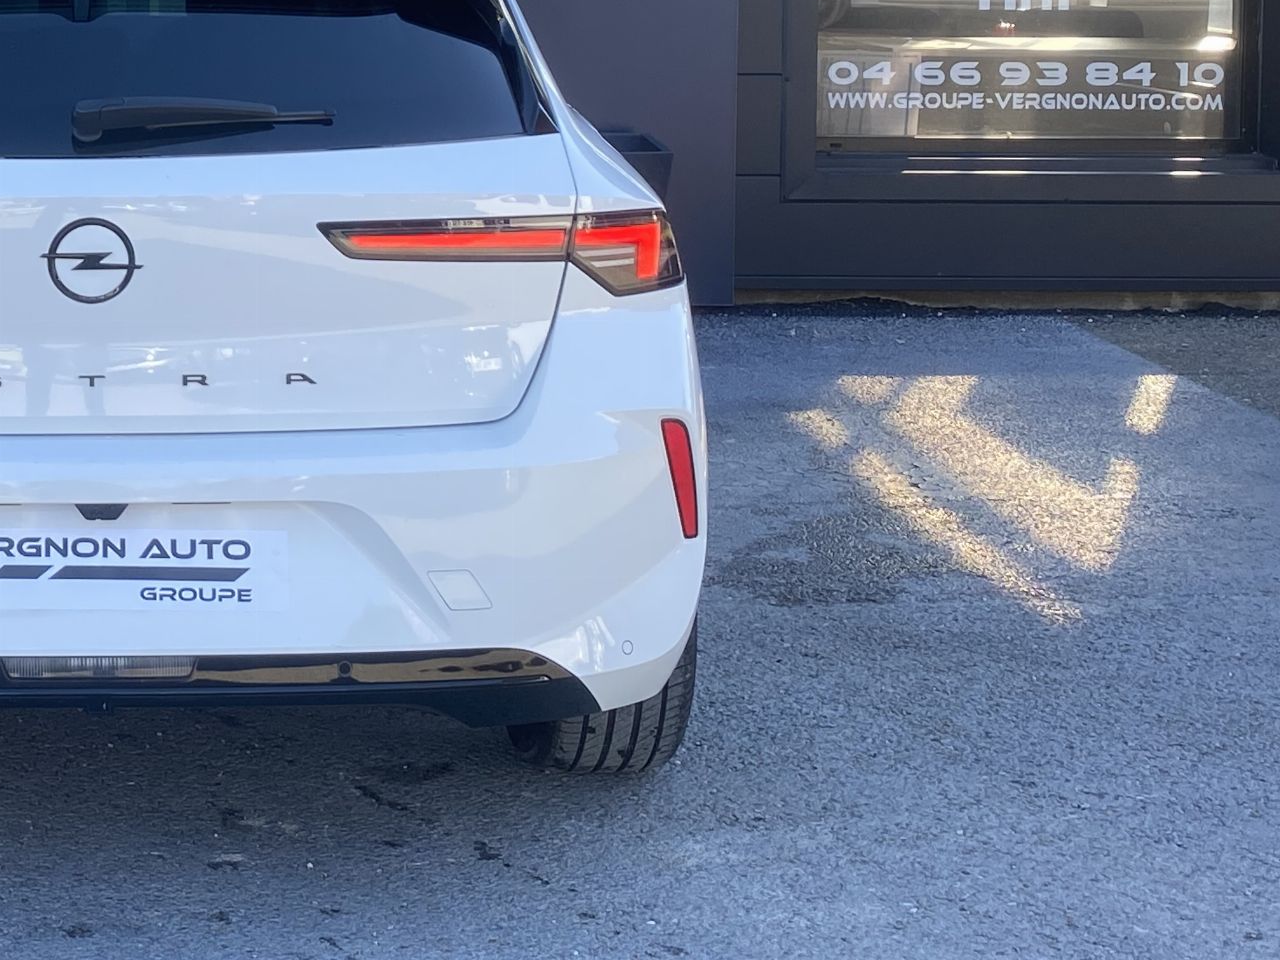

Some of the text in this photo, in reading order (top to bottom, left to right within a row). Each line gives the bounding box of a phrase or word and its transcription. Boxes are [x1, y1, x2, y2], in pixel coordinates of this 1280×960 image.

[827, 60, 1225, 87] 04 66 93 84 10
[827, 90, 1225, 112] WWW.GROUPE-VERGNONAUTO.COM
[138, 538, 252, 561] AUTO
[139, 586, 253, 604] GROUPE
